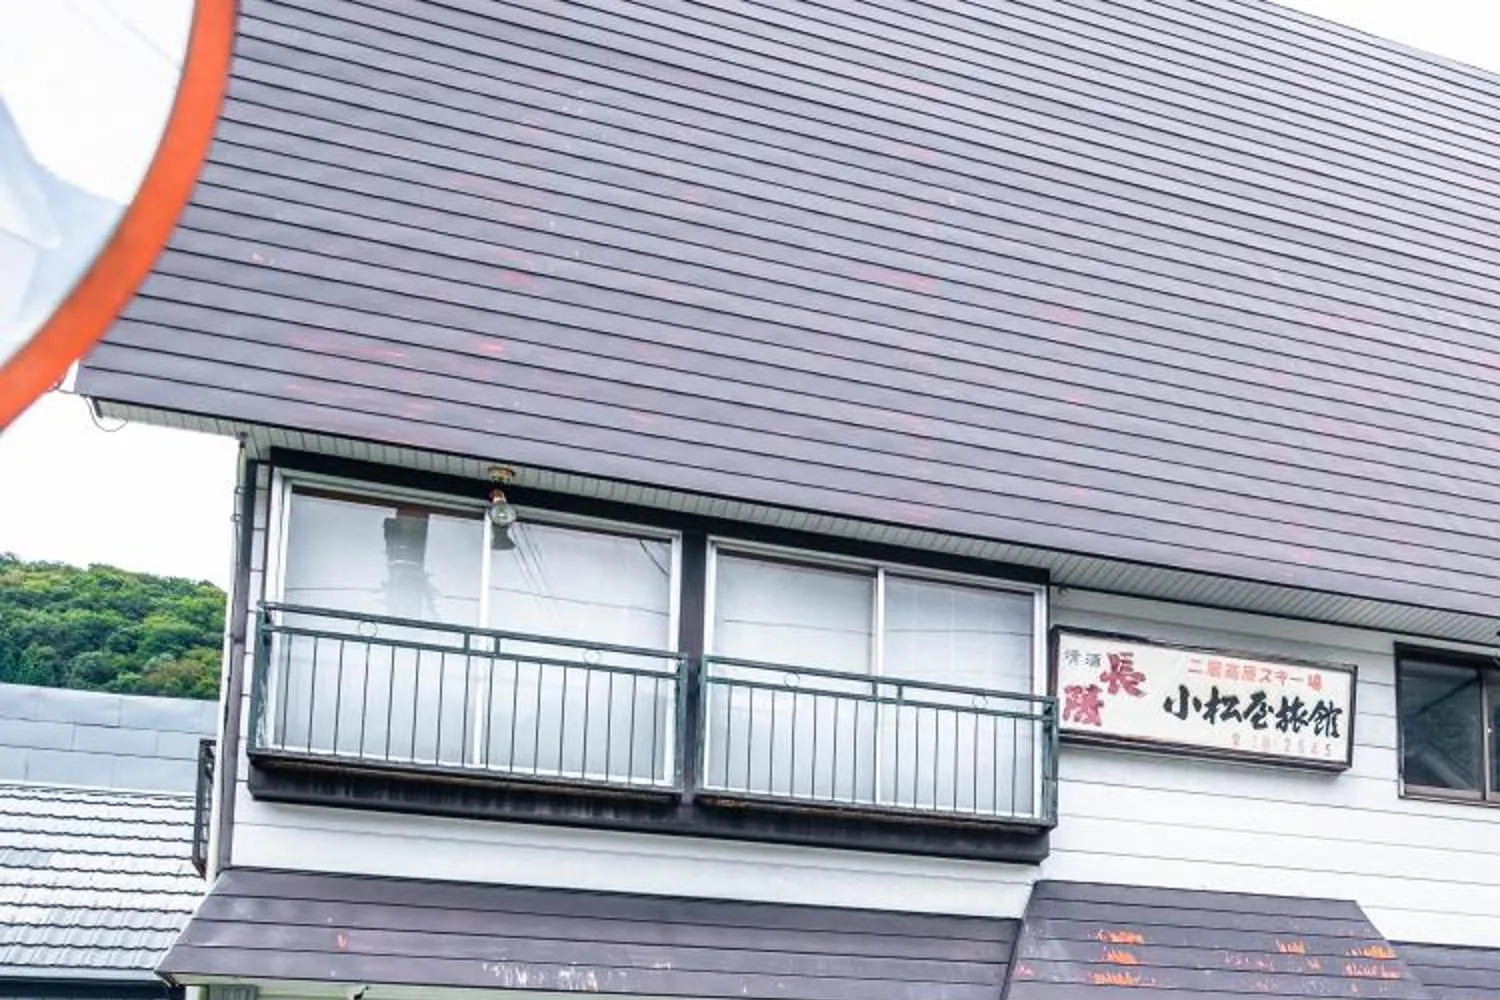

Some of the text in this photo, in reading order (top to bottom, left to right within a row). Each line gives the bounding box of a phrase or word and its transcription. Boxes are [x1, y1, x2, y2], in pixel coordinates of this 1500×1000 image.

[1163, 684, 1344, 739] 小松屋旅館
